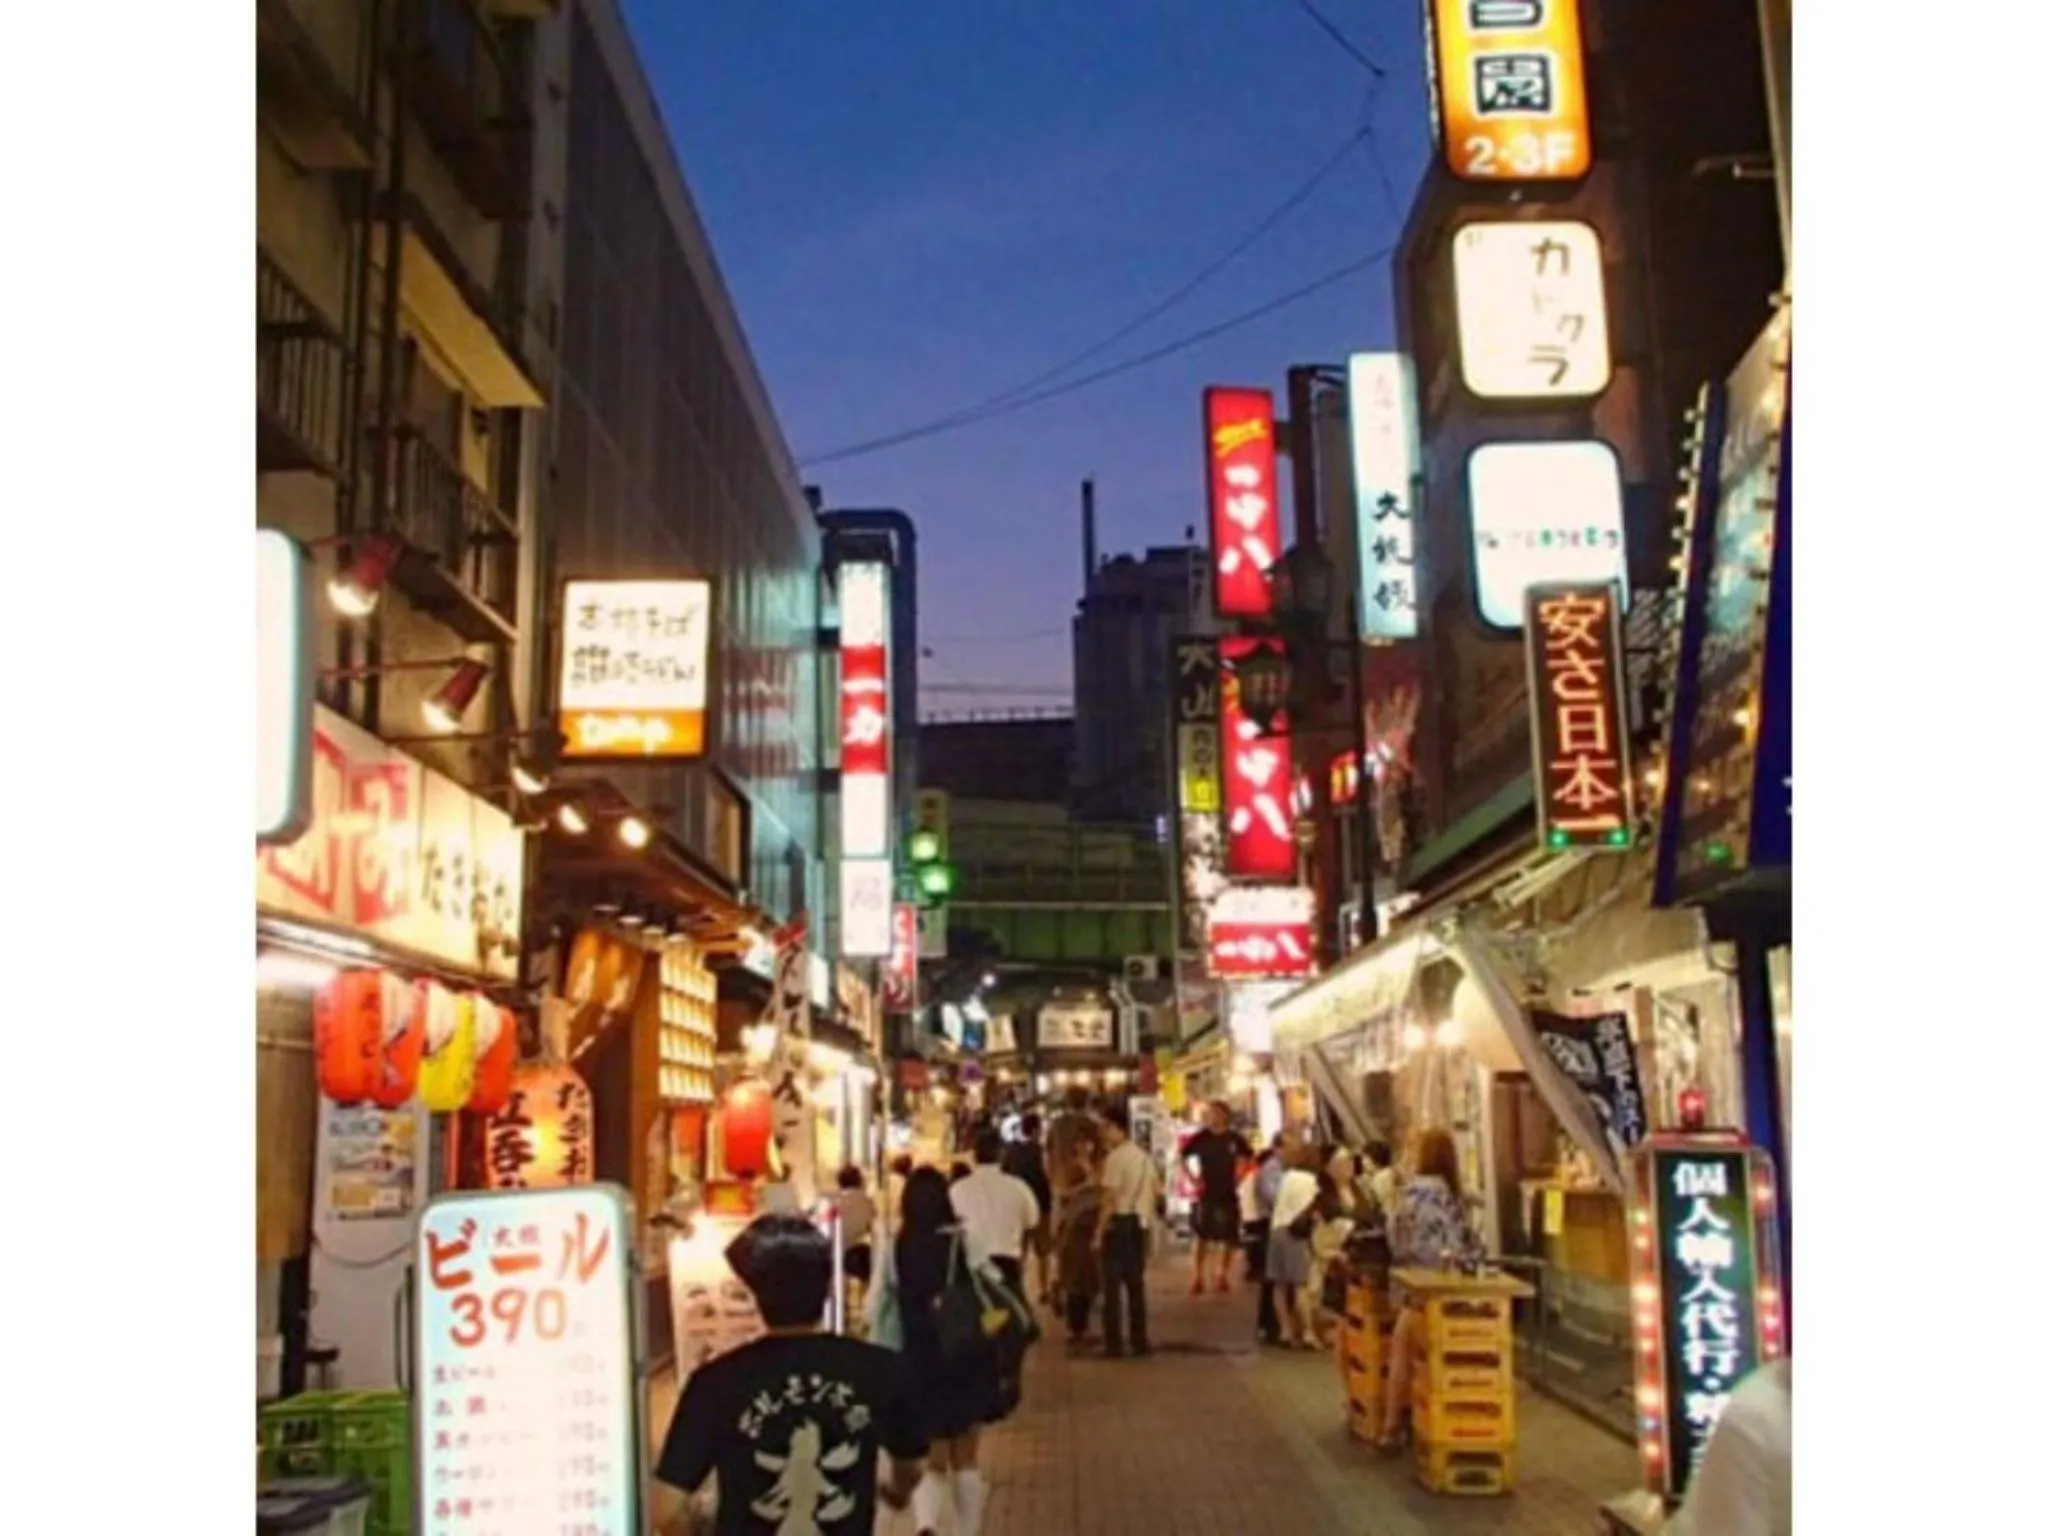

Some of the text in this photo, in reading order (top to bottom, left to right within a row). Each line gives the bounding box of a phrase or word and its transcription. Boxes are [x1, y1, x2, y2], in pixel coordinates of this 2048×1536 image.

[1537, 592, 1623, 830] 安さ日本一
[425, 1211, 610, 1290] ビール
[449, 1287, 566, 1347] 390
